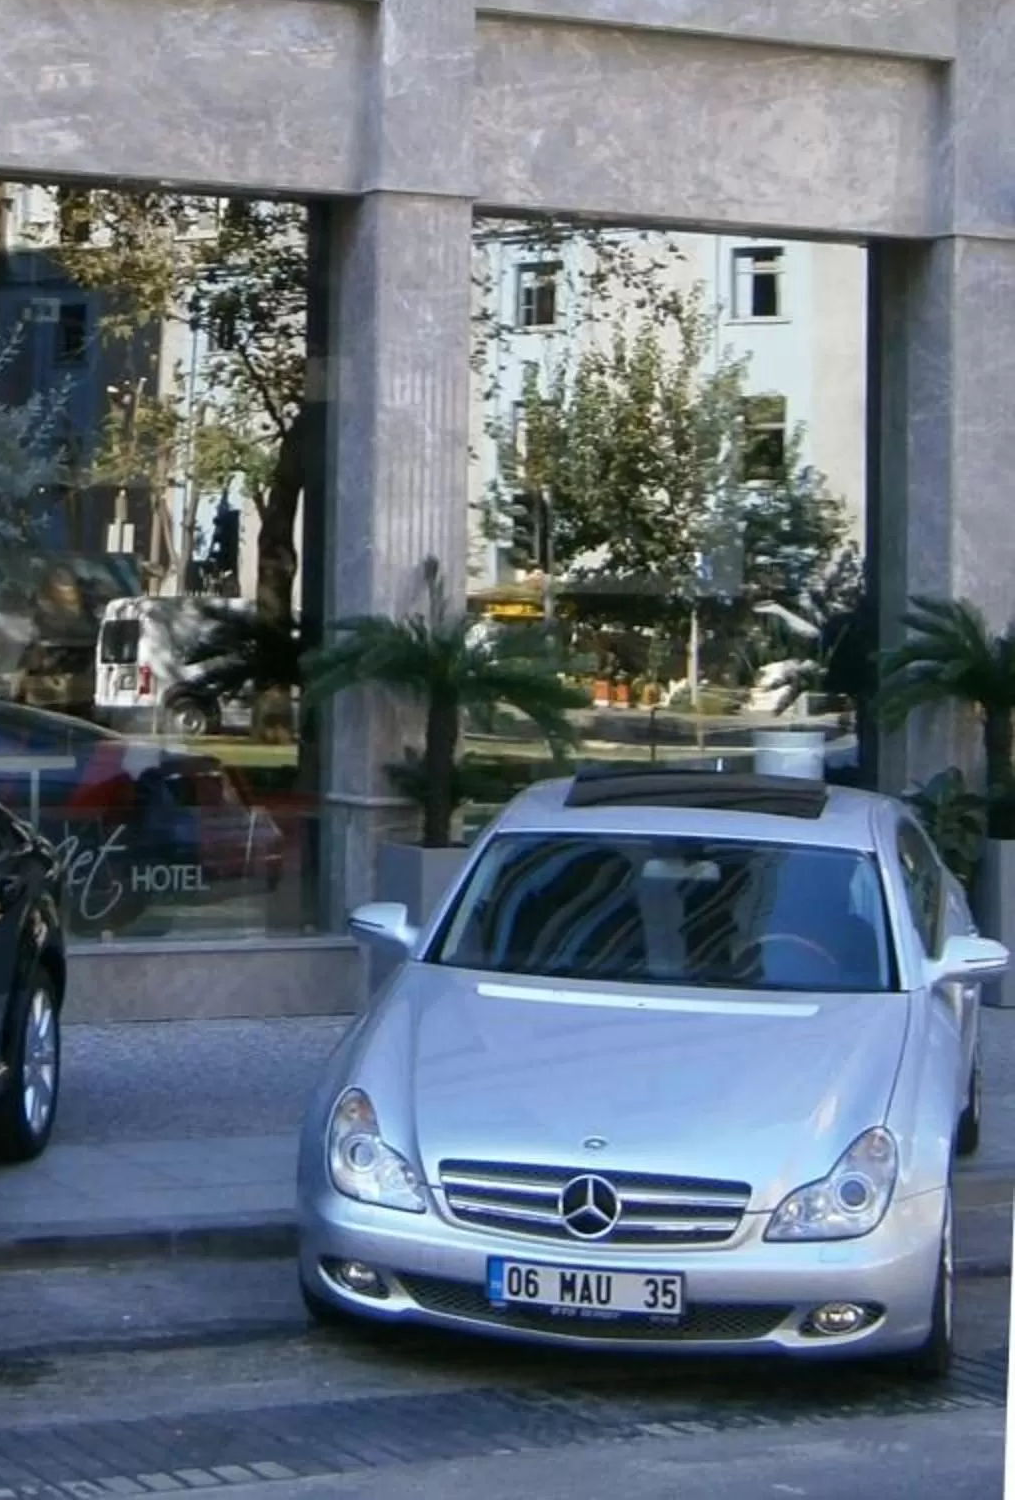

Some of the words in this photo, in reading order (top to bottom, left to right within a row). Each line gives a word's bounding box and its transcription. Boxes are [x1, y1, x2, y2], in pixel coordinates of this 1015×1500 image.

[55, 823, 128, 920] et
[130, 864, 211, 892] HOTEL
[507, 1265, 540, 1299] 06
[558, 1271, 612, 1306] MAU
[642, 1277, 678, 1310] 35
